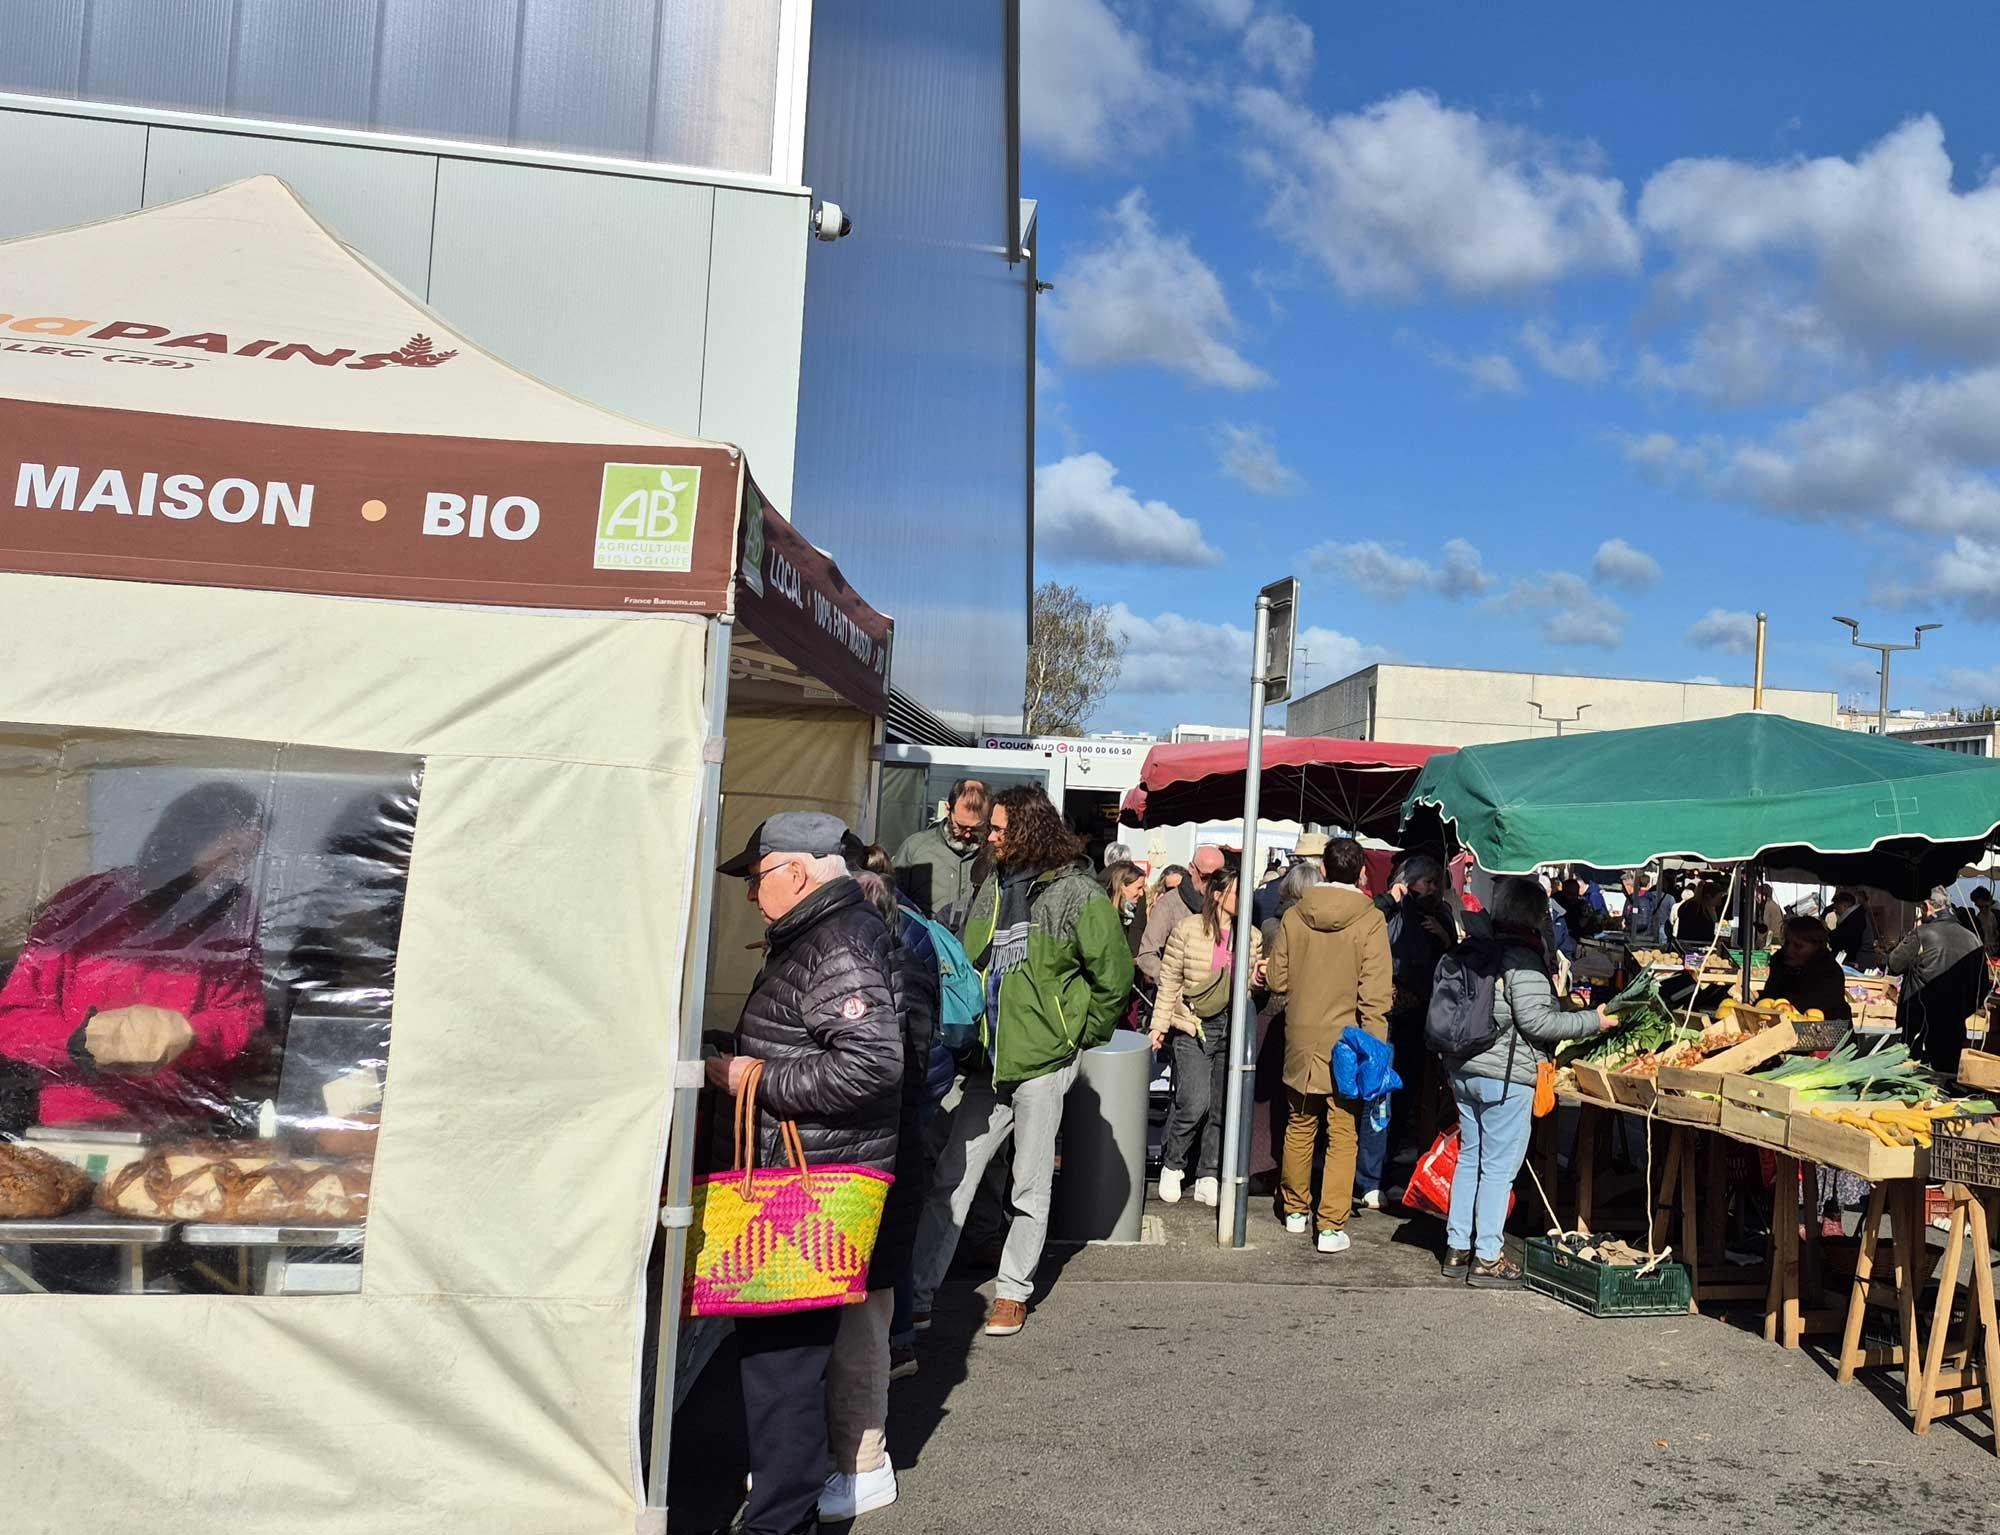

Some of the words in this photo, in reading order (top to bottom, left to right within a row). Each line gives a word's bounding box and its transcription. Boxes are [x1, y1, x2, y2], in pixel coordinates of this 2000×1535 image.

[0, 342, 94, 358] LEC
[102, 354, 194, 370] (29)
[14, 462, 314, 528] MAISON
[422, 492, 540, 541] BIO
[606, 489, 679, 537] AB
[598, 542, 689, 554] AGRICULTURE
[597, 554, 689, 566] BIOLOGIQUE
[624, 597, 652, 605] France
[653, 598, 706, 606] Barnums.com
[770, 547, 803, 610] LOCAL
[833, 604, 848, 646] FAIT
[1000, 741, 1055, 751] COUGNAUD
